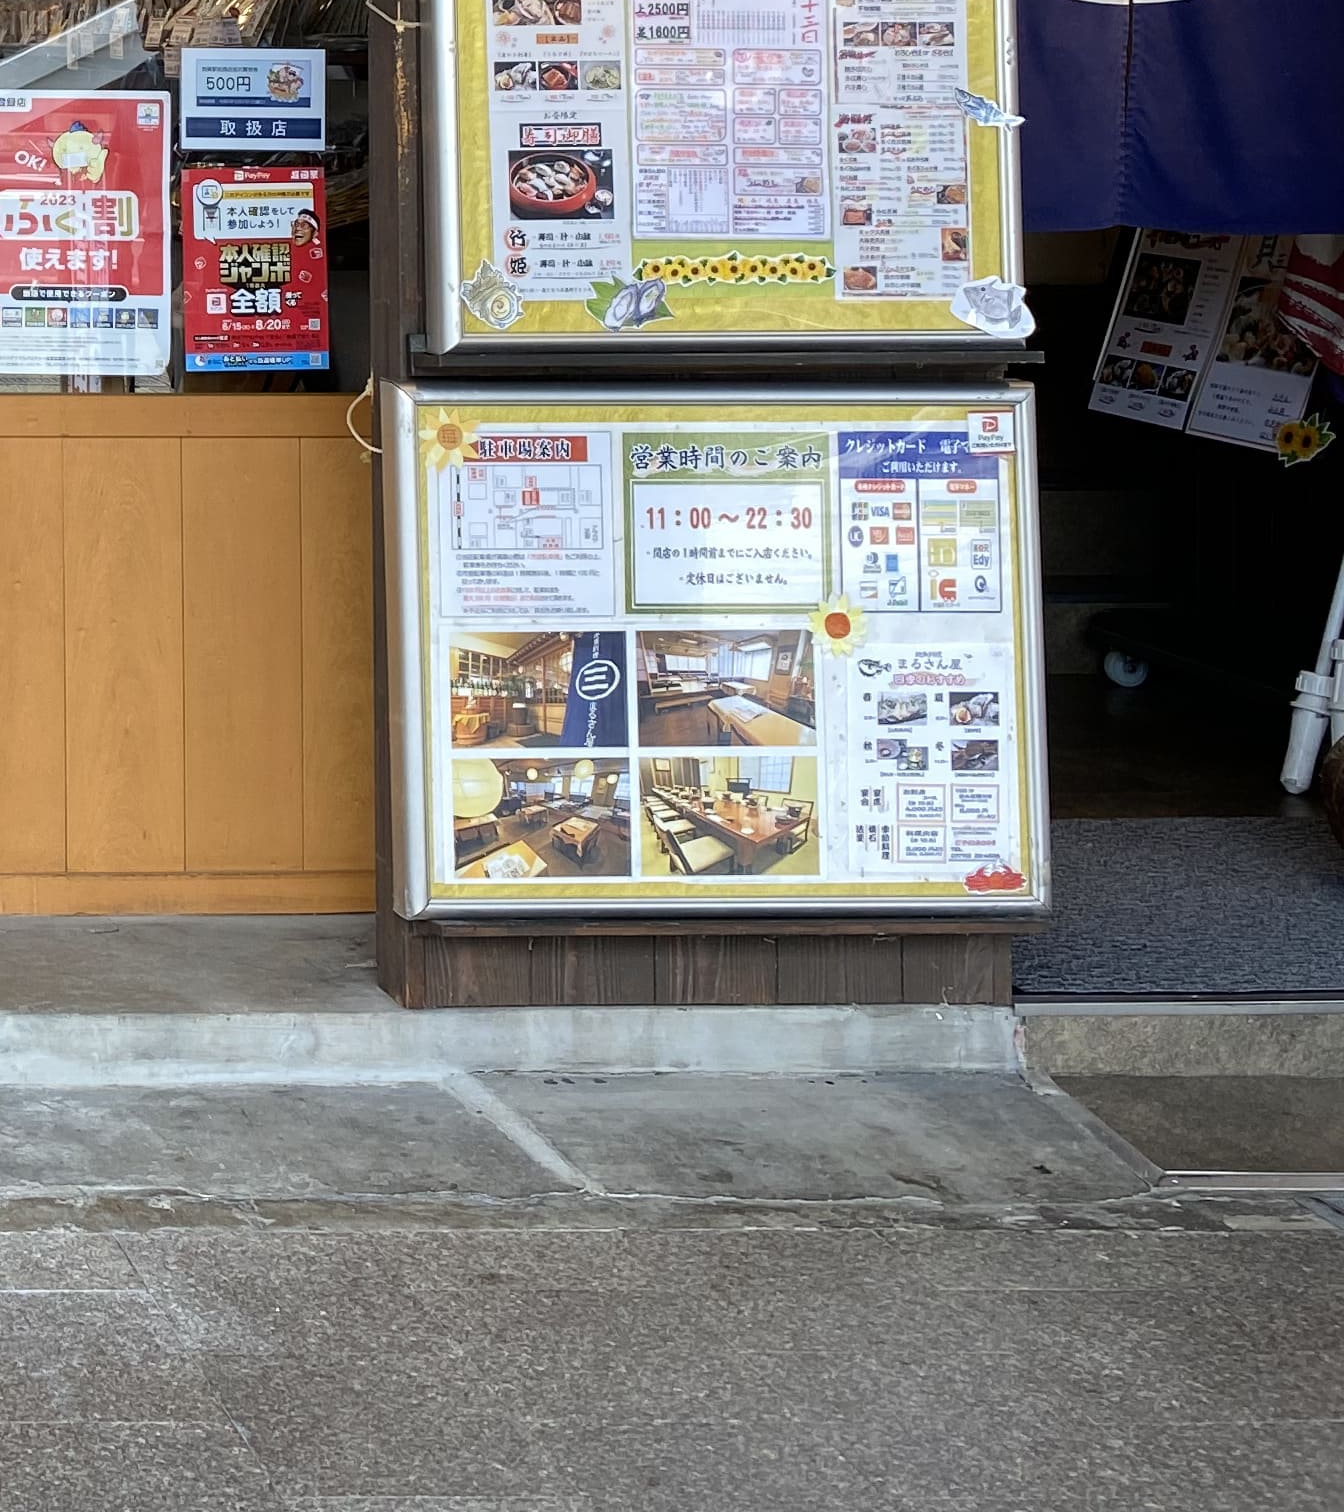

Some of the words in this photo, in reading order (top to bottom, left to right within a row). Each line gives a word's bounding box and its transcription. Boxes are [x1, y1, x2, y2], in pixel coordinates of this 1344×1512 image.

[206, 75, 252, 93] 500円
[219, 120, 288, 137] 取扱店
[14, 149, 48, 172] OK!
[244, 170, 272, 180] PayPay
[40, 195, 77, 206] 2023
[4, 194, 133, 237] ふく割
[226, 205, 295, 218] 本人確認をして
[219, 243, 291, 262] 本人確認
[220, 262, 291, 283] ジャンボ
[230, 289, 283, 314] 全額
[478, 439, 571, 459] 駐車場案内
[845, 439, 926, 454] クレジットカード
[630, 445, 823, 471] 営業時間のご案内
[871, 506, 890, 517] VISA
[973, 553, 989, 567] Edy
